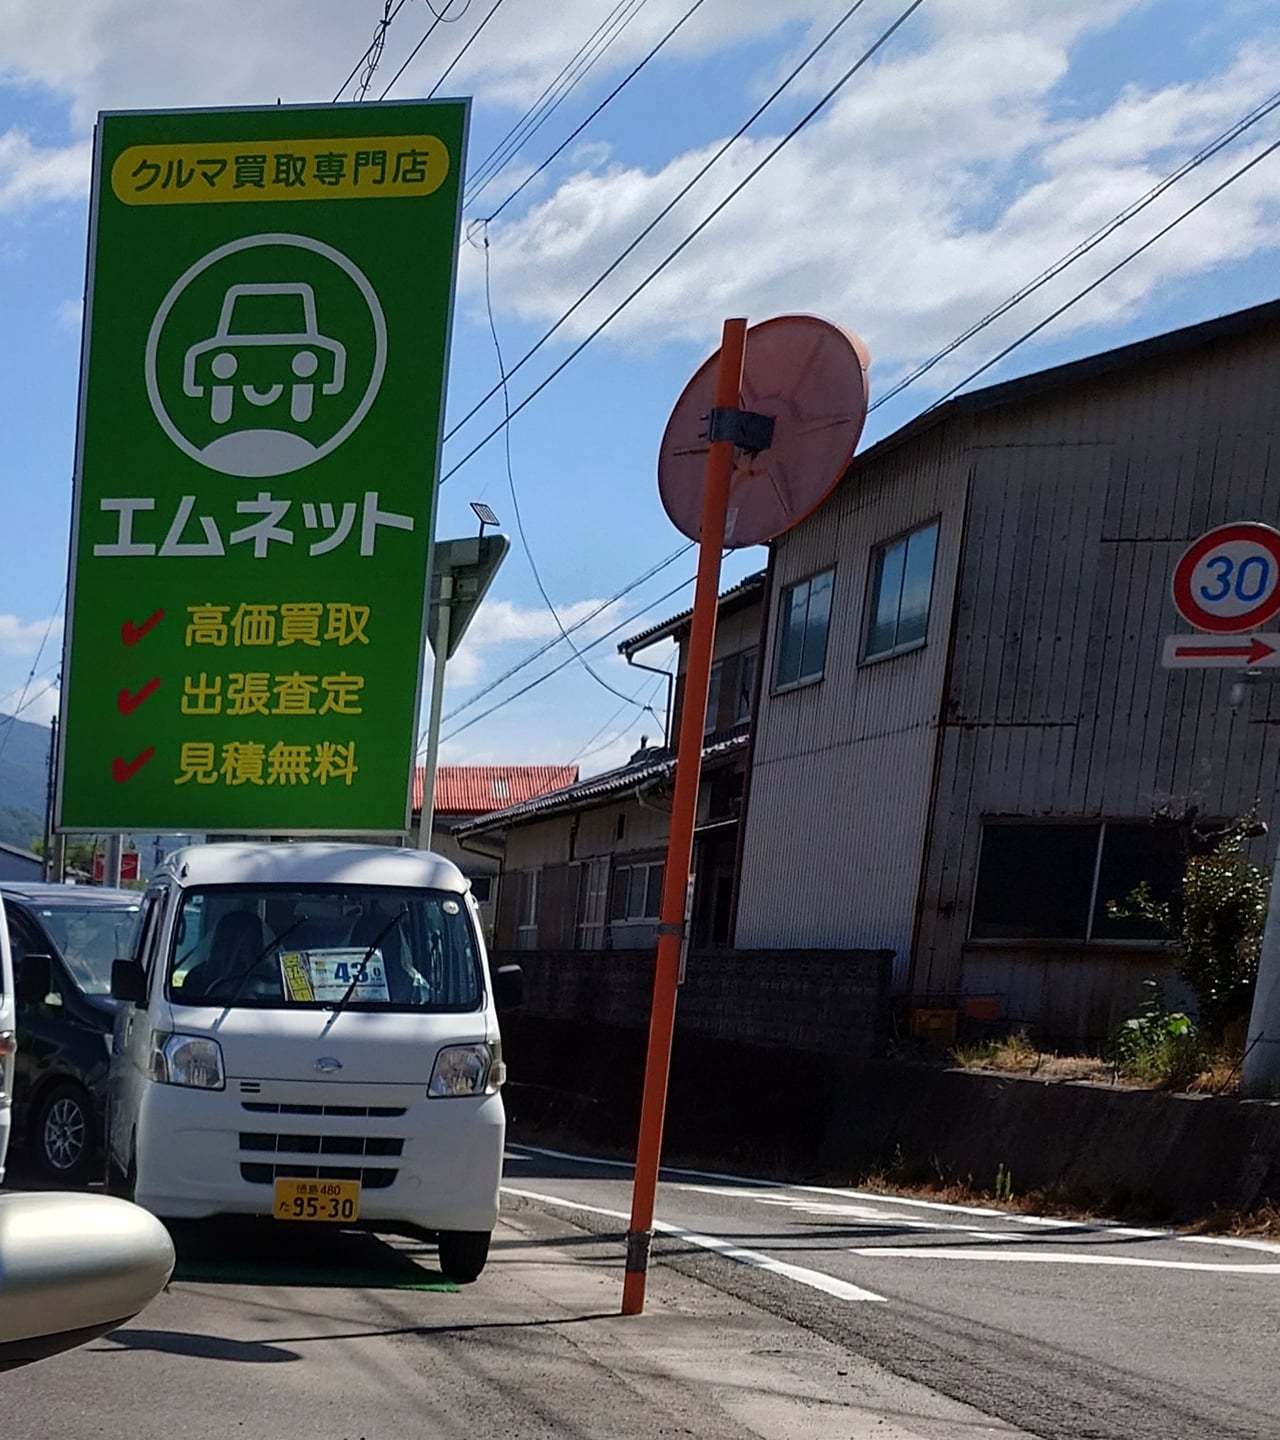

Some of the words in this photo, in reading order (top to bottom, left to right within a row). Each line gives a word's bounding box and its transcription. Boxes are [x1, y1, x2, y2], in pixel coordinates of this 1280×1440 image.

[130, 147, 430, 193] クルマ買取専門店
[93, 491, 415, 559] エムネット
[1200, 555, 1270, 602] 30
[184, 602, 371, 648] 高価買取
[179, 672, 365, 716] 出張査定
[173, 742, 359, 787] 見積無料
[292, 1196, 354, 1218] 95-30
